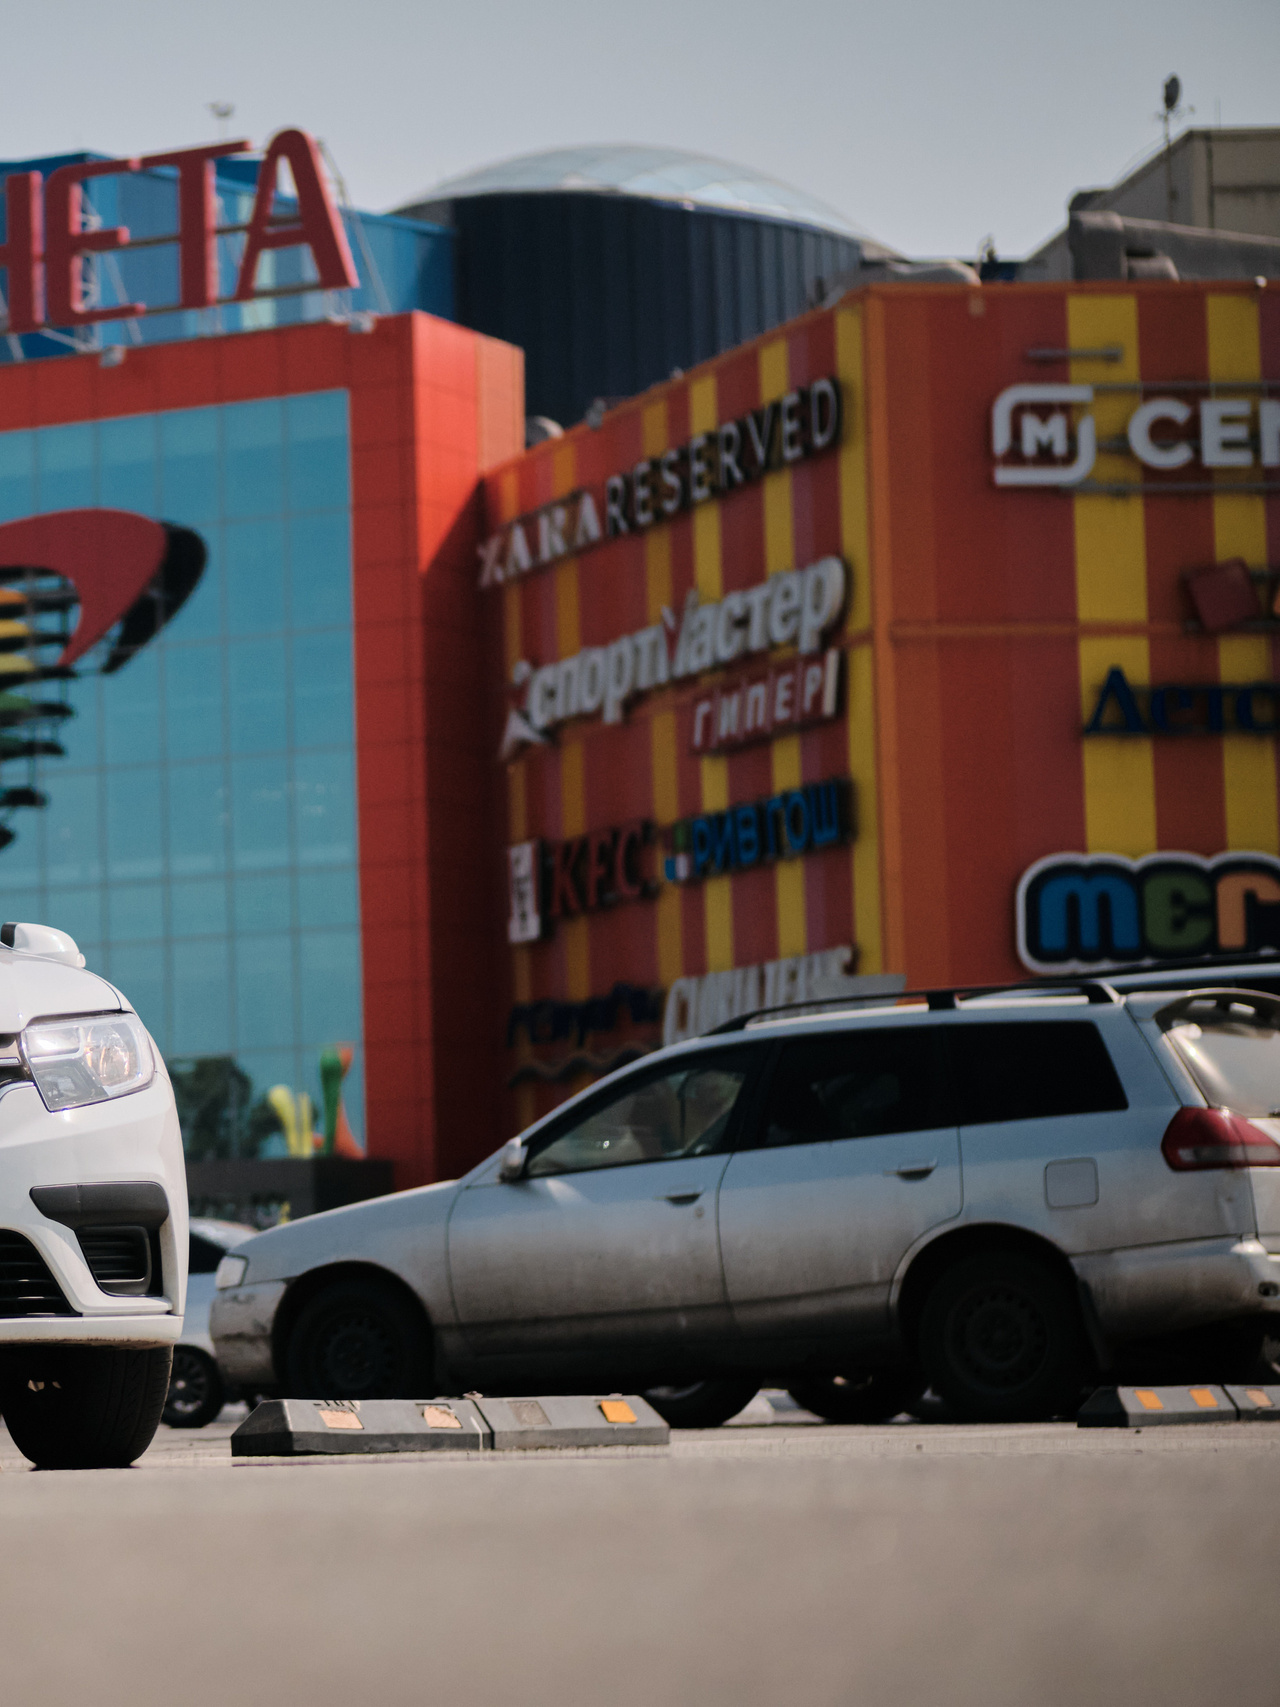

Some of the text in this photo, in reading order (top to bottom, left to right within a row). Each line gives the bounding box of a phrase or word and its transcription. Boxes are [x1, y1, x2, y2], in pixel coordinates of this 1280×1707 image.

[606, 377, 842, 538] RESERVED
[692, 664, 823, 748] ГИПЕР
[691, 782, 841, 877] РИВ ГОШ
